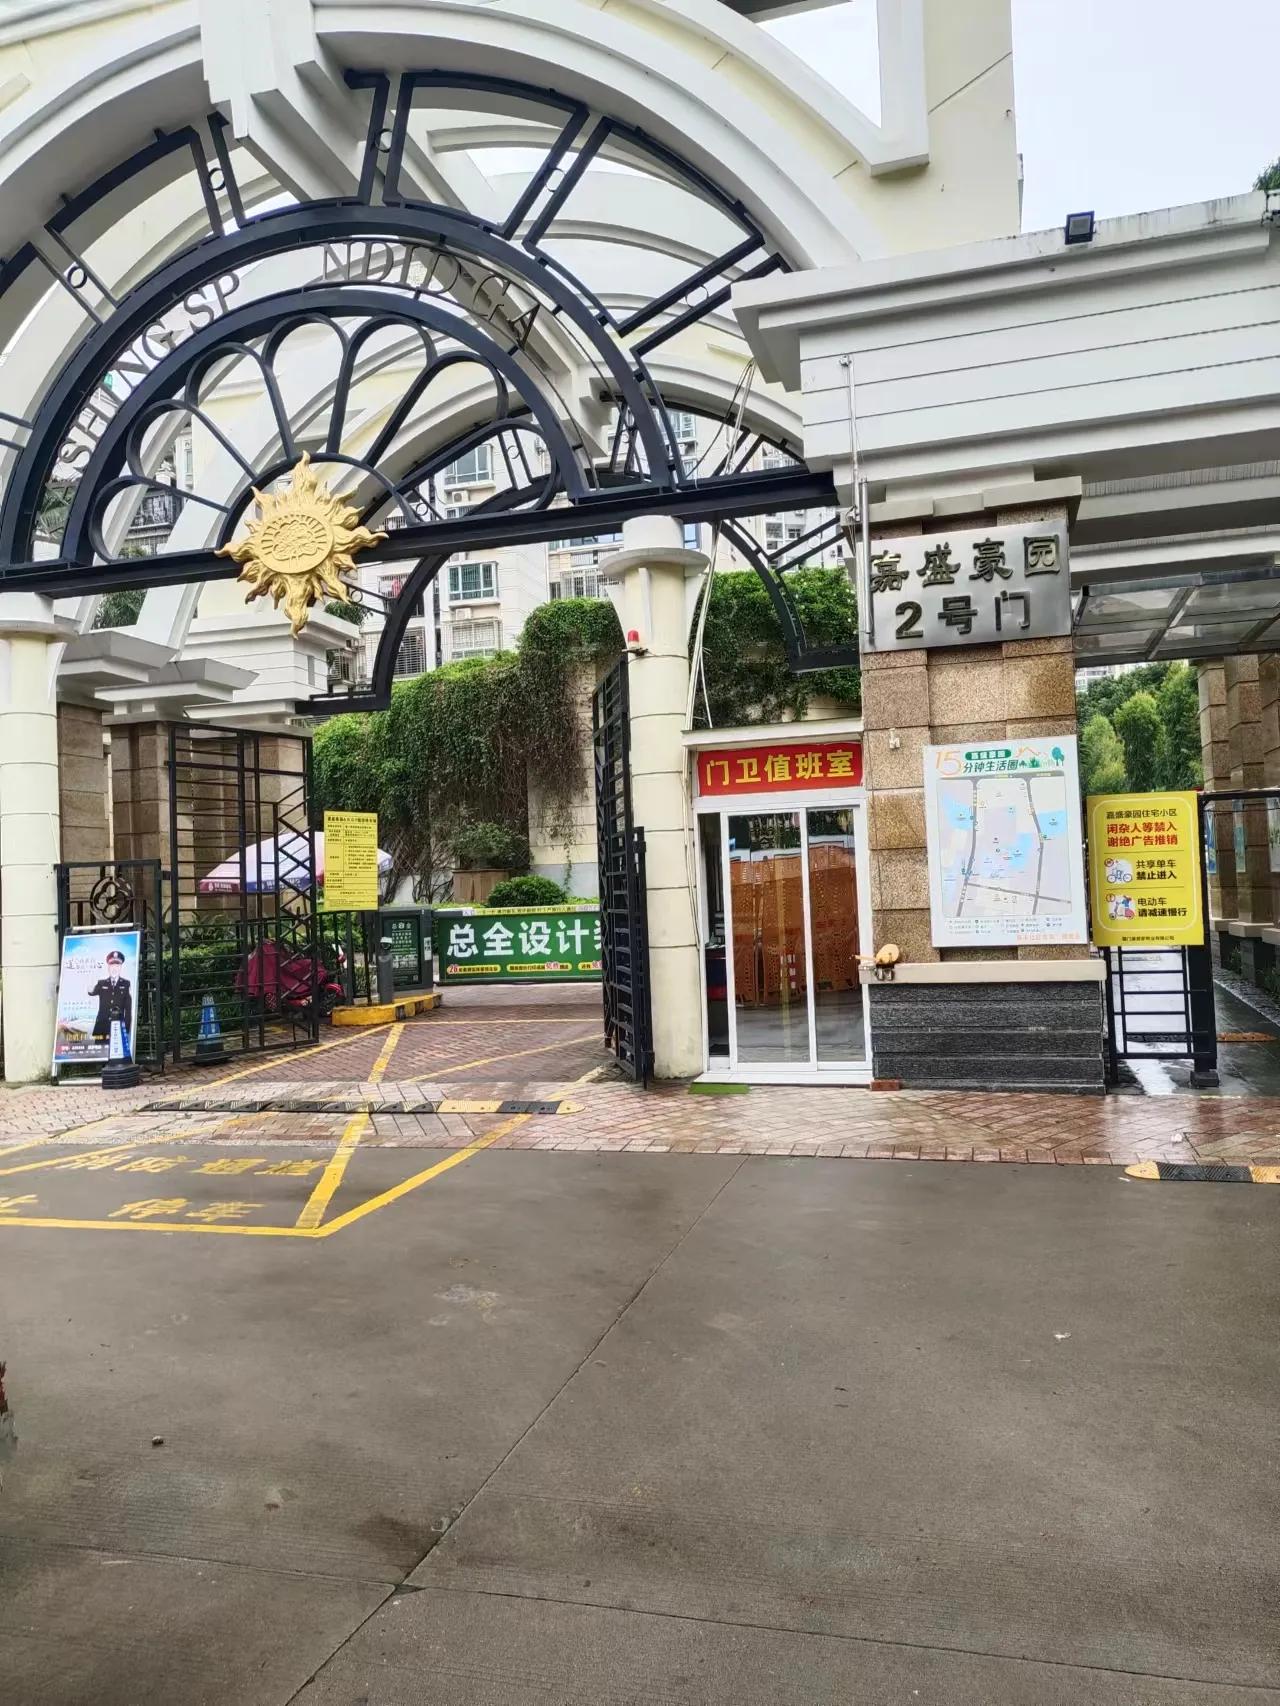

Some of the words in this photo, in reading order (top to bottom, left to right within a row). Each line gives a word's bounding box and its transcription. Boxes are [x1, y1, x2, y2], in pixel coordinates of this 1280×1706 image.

[869, 534, 1060, 593] 嘉盛豪园
[895, 590, 1031, 640] 2号门
[706, 750, 854, 786] 门卫值班室
[963, 759, 1019, 773] 分钟生活圈
[1106, 809, 1178, 819] 嘉盛豪园住宅小区
[1107, 822, 1177, 834] 闲杂人等禁入
[1107, 834, 1178, 847] 谢绝广告推销
[1136, 860, 1176, 869] 共享单车
[1136, 870, 1177, 880] 禁止进入
[1138, 897, 1167, 906] 电动车
[1138, 907, 1187, 917] 请减速慢行
[56, 1152, 328, 1176] 消防通道
